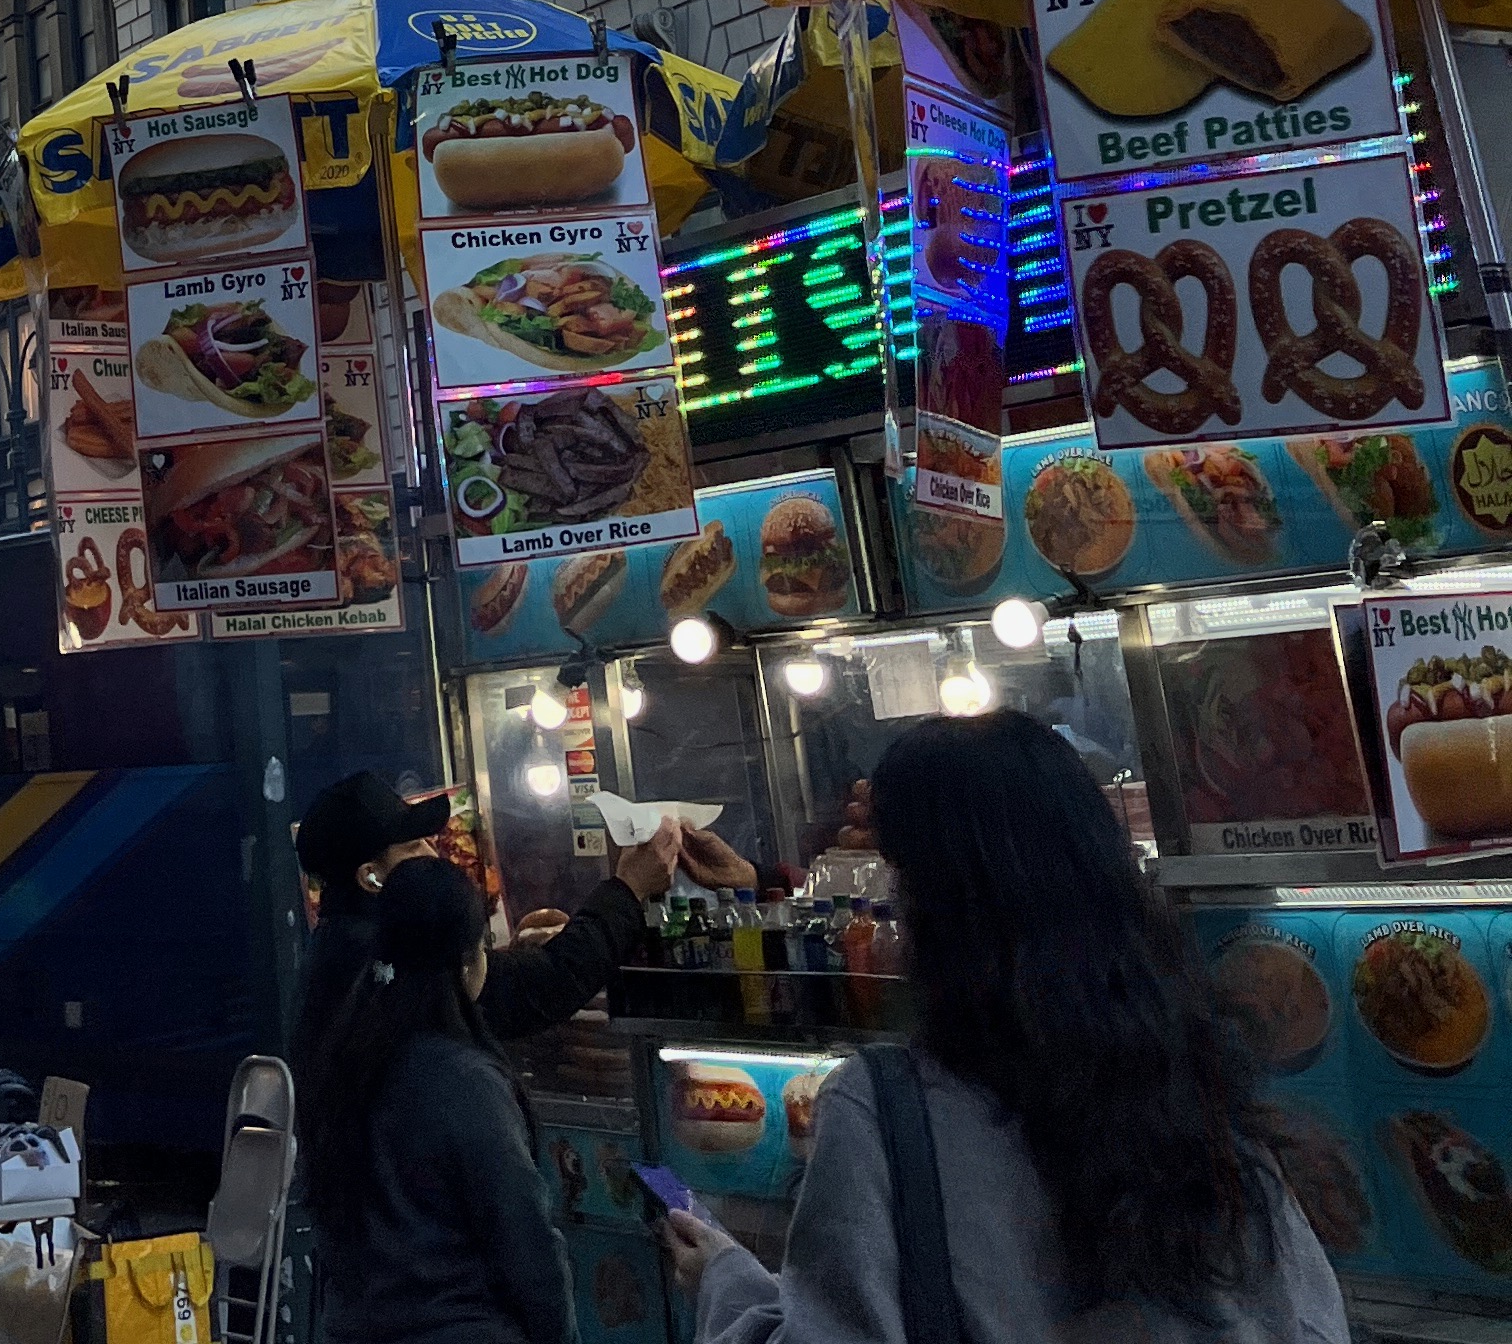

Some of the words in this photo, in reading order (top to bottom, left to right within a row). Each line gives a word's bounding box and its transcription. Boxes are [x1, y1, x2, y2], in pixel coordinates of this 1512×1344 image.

[126, 13, 347, 84] SABRETT
[424, 72, 431, 85] I
[451, 68, 502, 89] Best
[529, 65, 569, 83] Hot
[576, 62, 619, 83] Dog
[420, 82, 445, 96] NY
[147, 118, 178, 139] Hot
[182, 107, 260, 131] Sausage
[910, 120, 929, 144] NY
[930, 103, 968, 135] Cheese
[969, 120, 986, 145] Hot
[111, 127, 119, 143] I
[1098, 120, 1190, 165] Beef
[1205, 104, 1353, 145] Patties
[113, 138, 136, 156] NY
[319, 164, 350, 181] 2020
[1146, 177, 1318, 234] Pretzel
[1073, 204, 1087, 228] I
[451, 229, 542, 249] Chicken
[549, 226, 604, 244] Gyro
[616, 222, 626, 237] I
[1071, 223, 1114, 250] NY
[615, 235, 650, 254] NY
[282, 267, 291, 283] I
[163, 276, 215, 299] Lamb
[221, 272, 266, 293] Gyro
[281, 282, 309, 302] NY
[60, 321, 99, 338] Italian
[101, 323, 127, 338] Saus
[51, 357, 58, 373] I
[93, 359, 129, 377] Chur
[346, 359, 353, 374] I
[51, 373, 70, 390] NY
[344, 372, 371, 387] NY
[636, 386, 645, 401] I
[634, 400, 668, 420] NY
[1057, 446, 1084, 460] OVER
[930, 476, 959, 503] Chicken
[960, 483, 975, 506] Over
[975, 487, 991, 509] Rice
[85, 506, 130, 525] CHEESE
[58, 519, 76, 534] NY
[501, 532, 554, 554] Lamb
[559, 525, 604, 547] Over
[610, 520, 652, 539] Rice
[176, 582, 230, 602] Italian
[235, 578, 311, 599] Sausage
[225, 613, 269, 632] Halal
[271, 612, 335, 629] Chicken
[338, 609, 387, 625] Kebab
[1372, 608, 1381, 627] I
[1400, 608, 1452, 637] Best
[1373, 626, 1396, 648] NY
[574, 783, 595, 794] VISA
[1222, 825, 1295, 850] Chicken
[1299, 824, 1343, 846] Over
[1347, 821, 1378, 844] Ric
[1360, 924, 1390, 948] LAMB
[1392, 919, 1426, 934] OVER
[1428, 924, 1462, 950] RICE
